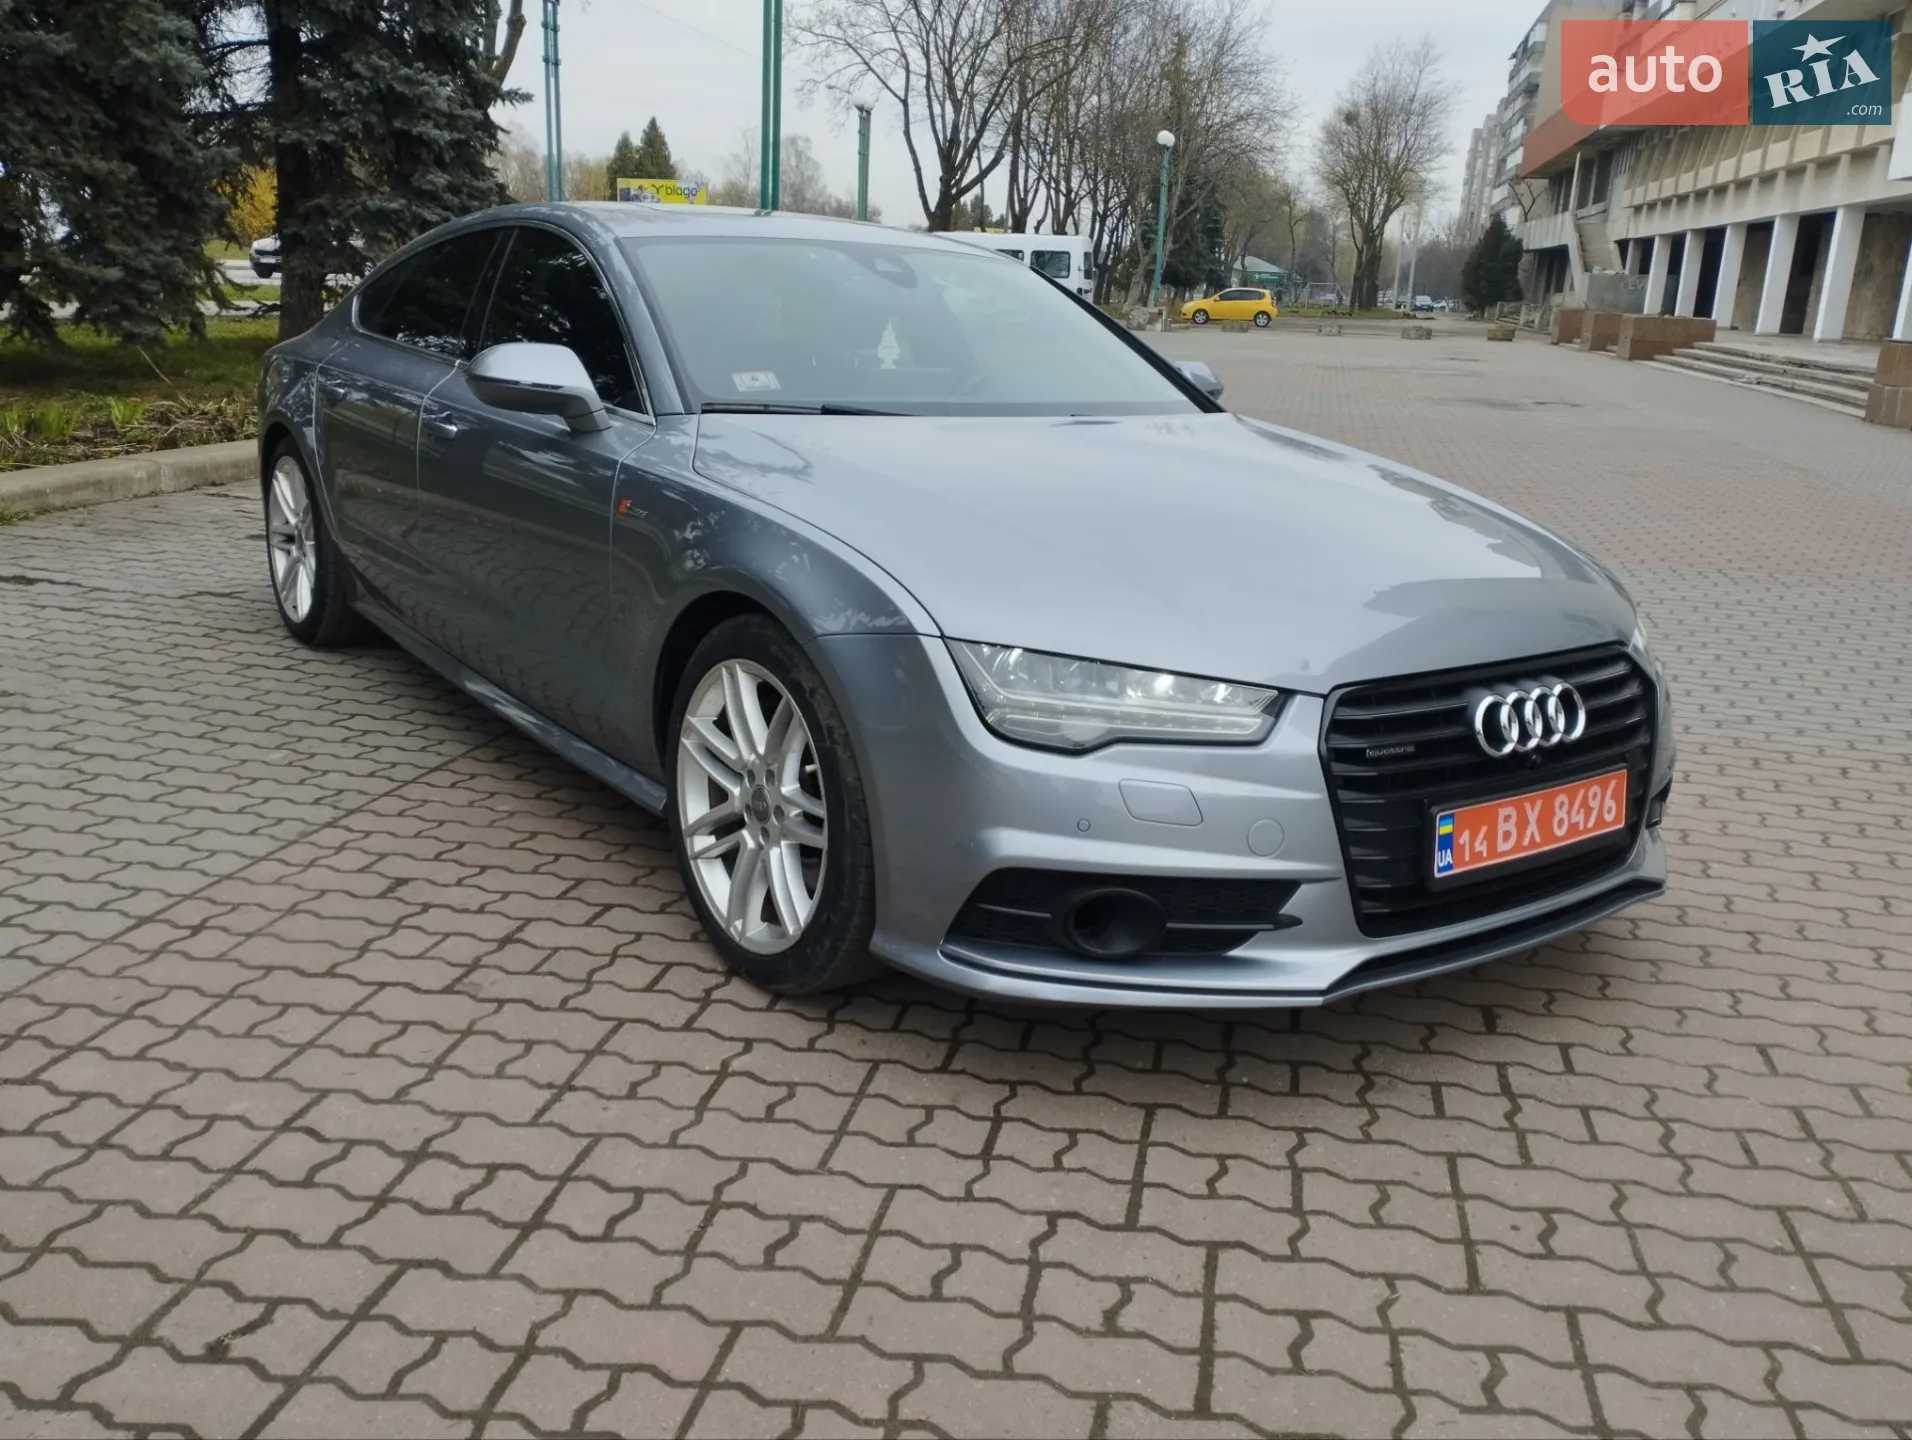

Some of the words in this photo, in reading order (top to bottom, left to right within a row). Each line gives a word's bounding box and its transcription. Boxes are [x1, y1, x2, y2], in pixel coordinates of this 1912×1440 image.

[1458, 825, 1488, 872] 14
[1497, 799, 1544, 853] BX
[1552, 779, 1618, 837] 8496
[1438, 849, 1453, 867] UA
